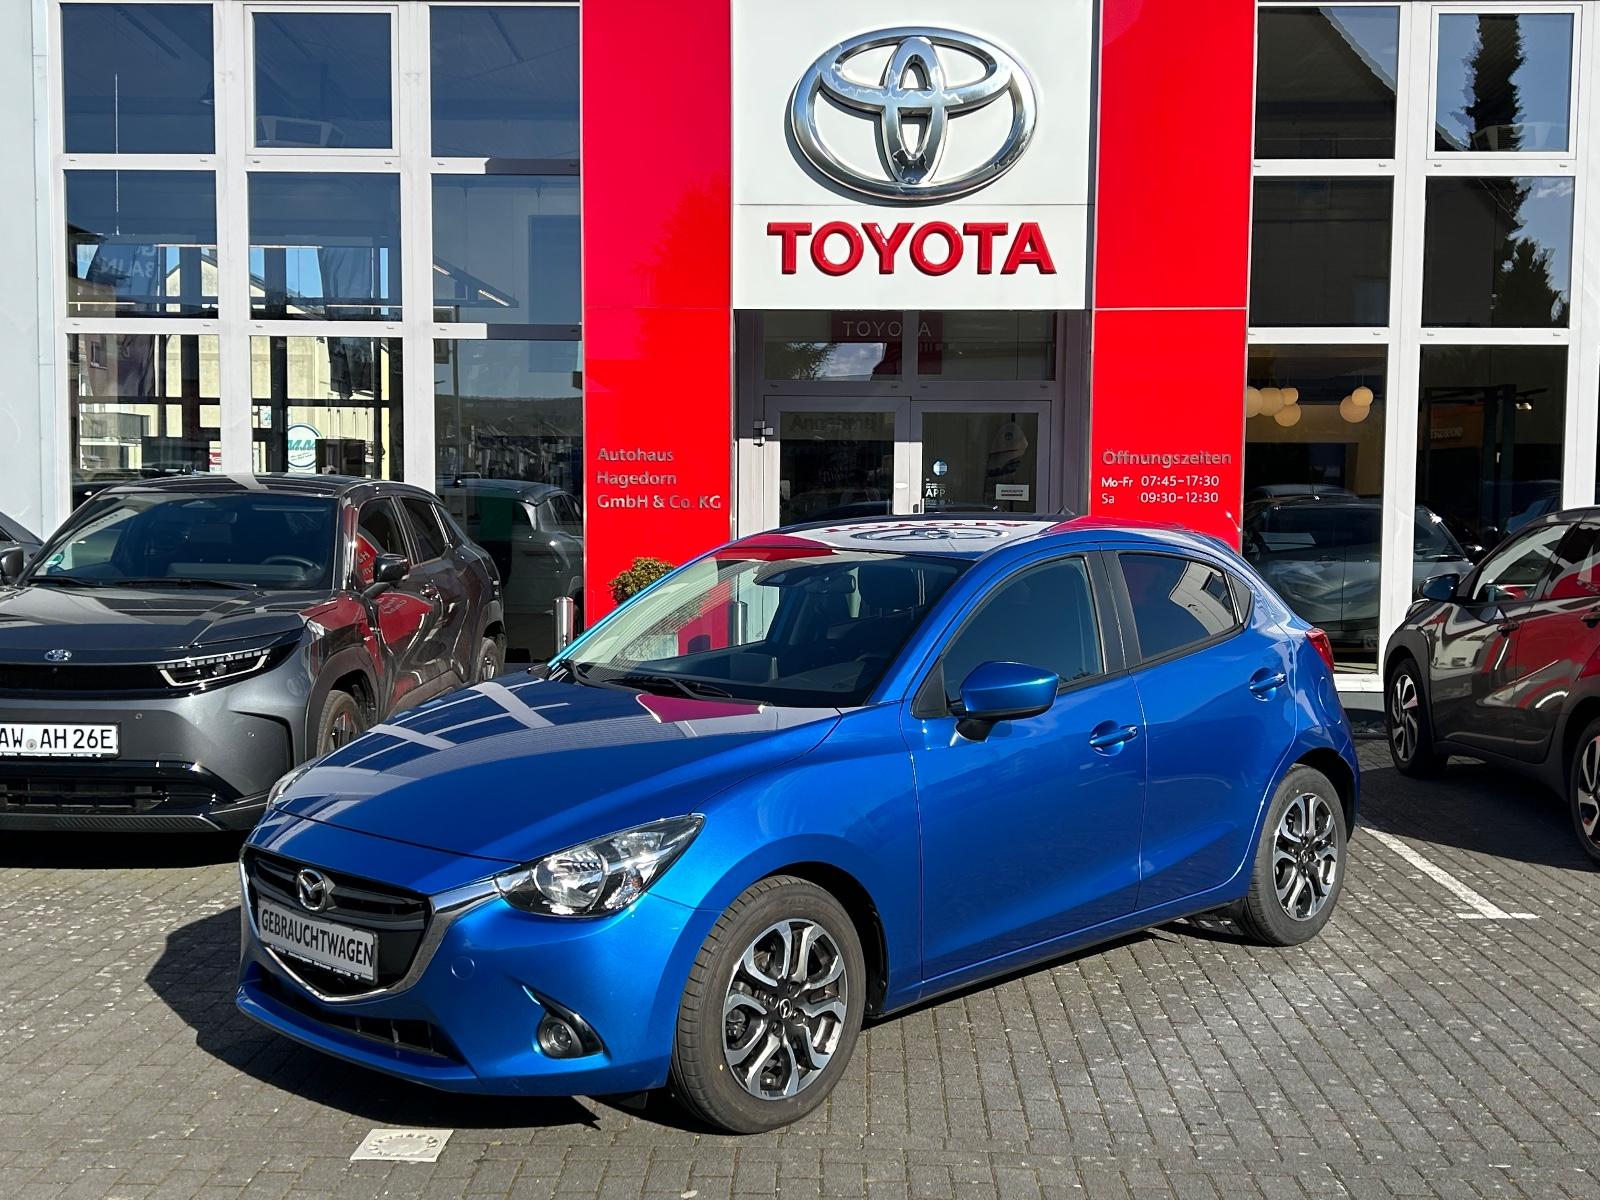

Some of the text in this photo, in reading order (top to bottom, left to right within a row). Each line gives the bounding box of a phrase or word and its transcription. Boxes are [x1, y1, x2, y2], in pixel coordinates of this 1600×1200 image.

[767, 221, 1057, 276] TOYOTA
[842, 320, 932, 337] TOYOA
[598, 447, 674, 462] Autohaus
[1102, 448, 1232, 469] Öffnungszeiten
[597, 470, 677, 489] Hagedorn
[1101, 475, 1220, 487] Mo-Fr 07:45-17:30
[597, 494, 721, 509] GmbH & Co. KG
[925, 488, 946, 498] APP
[1101, 492, 1219, 504] Sa 09:30-12:30
[0, 728, 113, 749] AW AH 26E
[261, 908, 374, 968] GEBRAUCHTWAGEN
